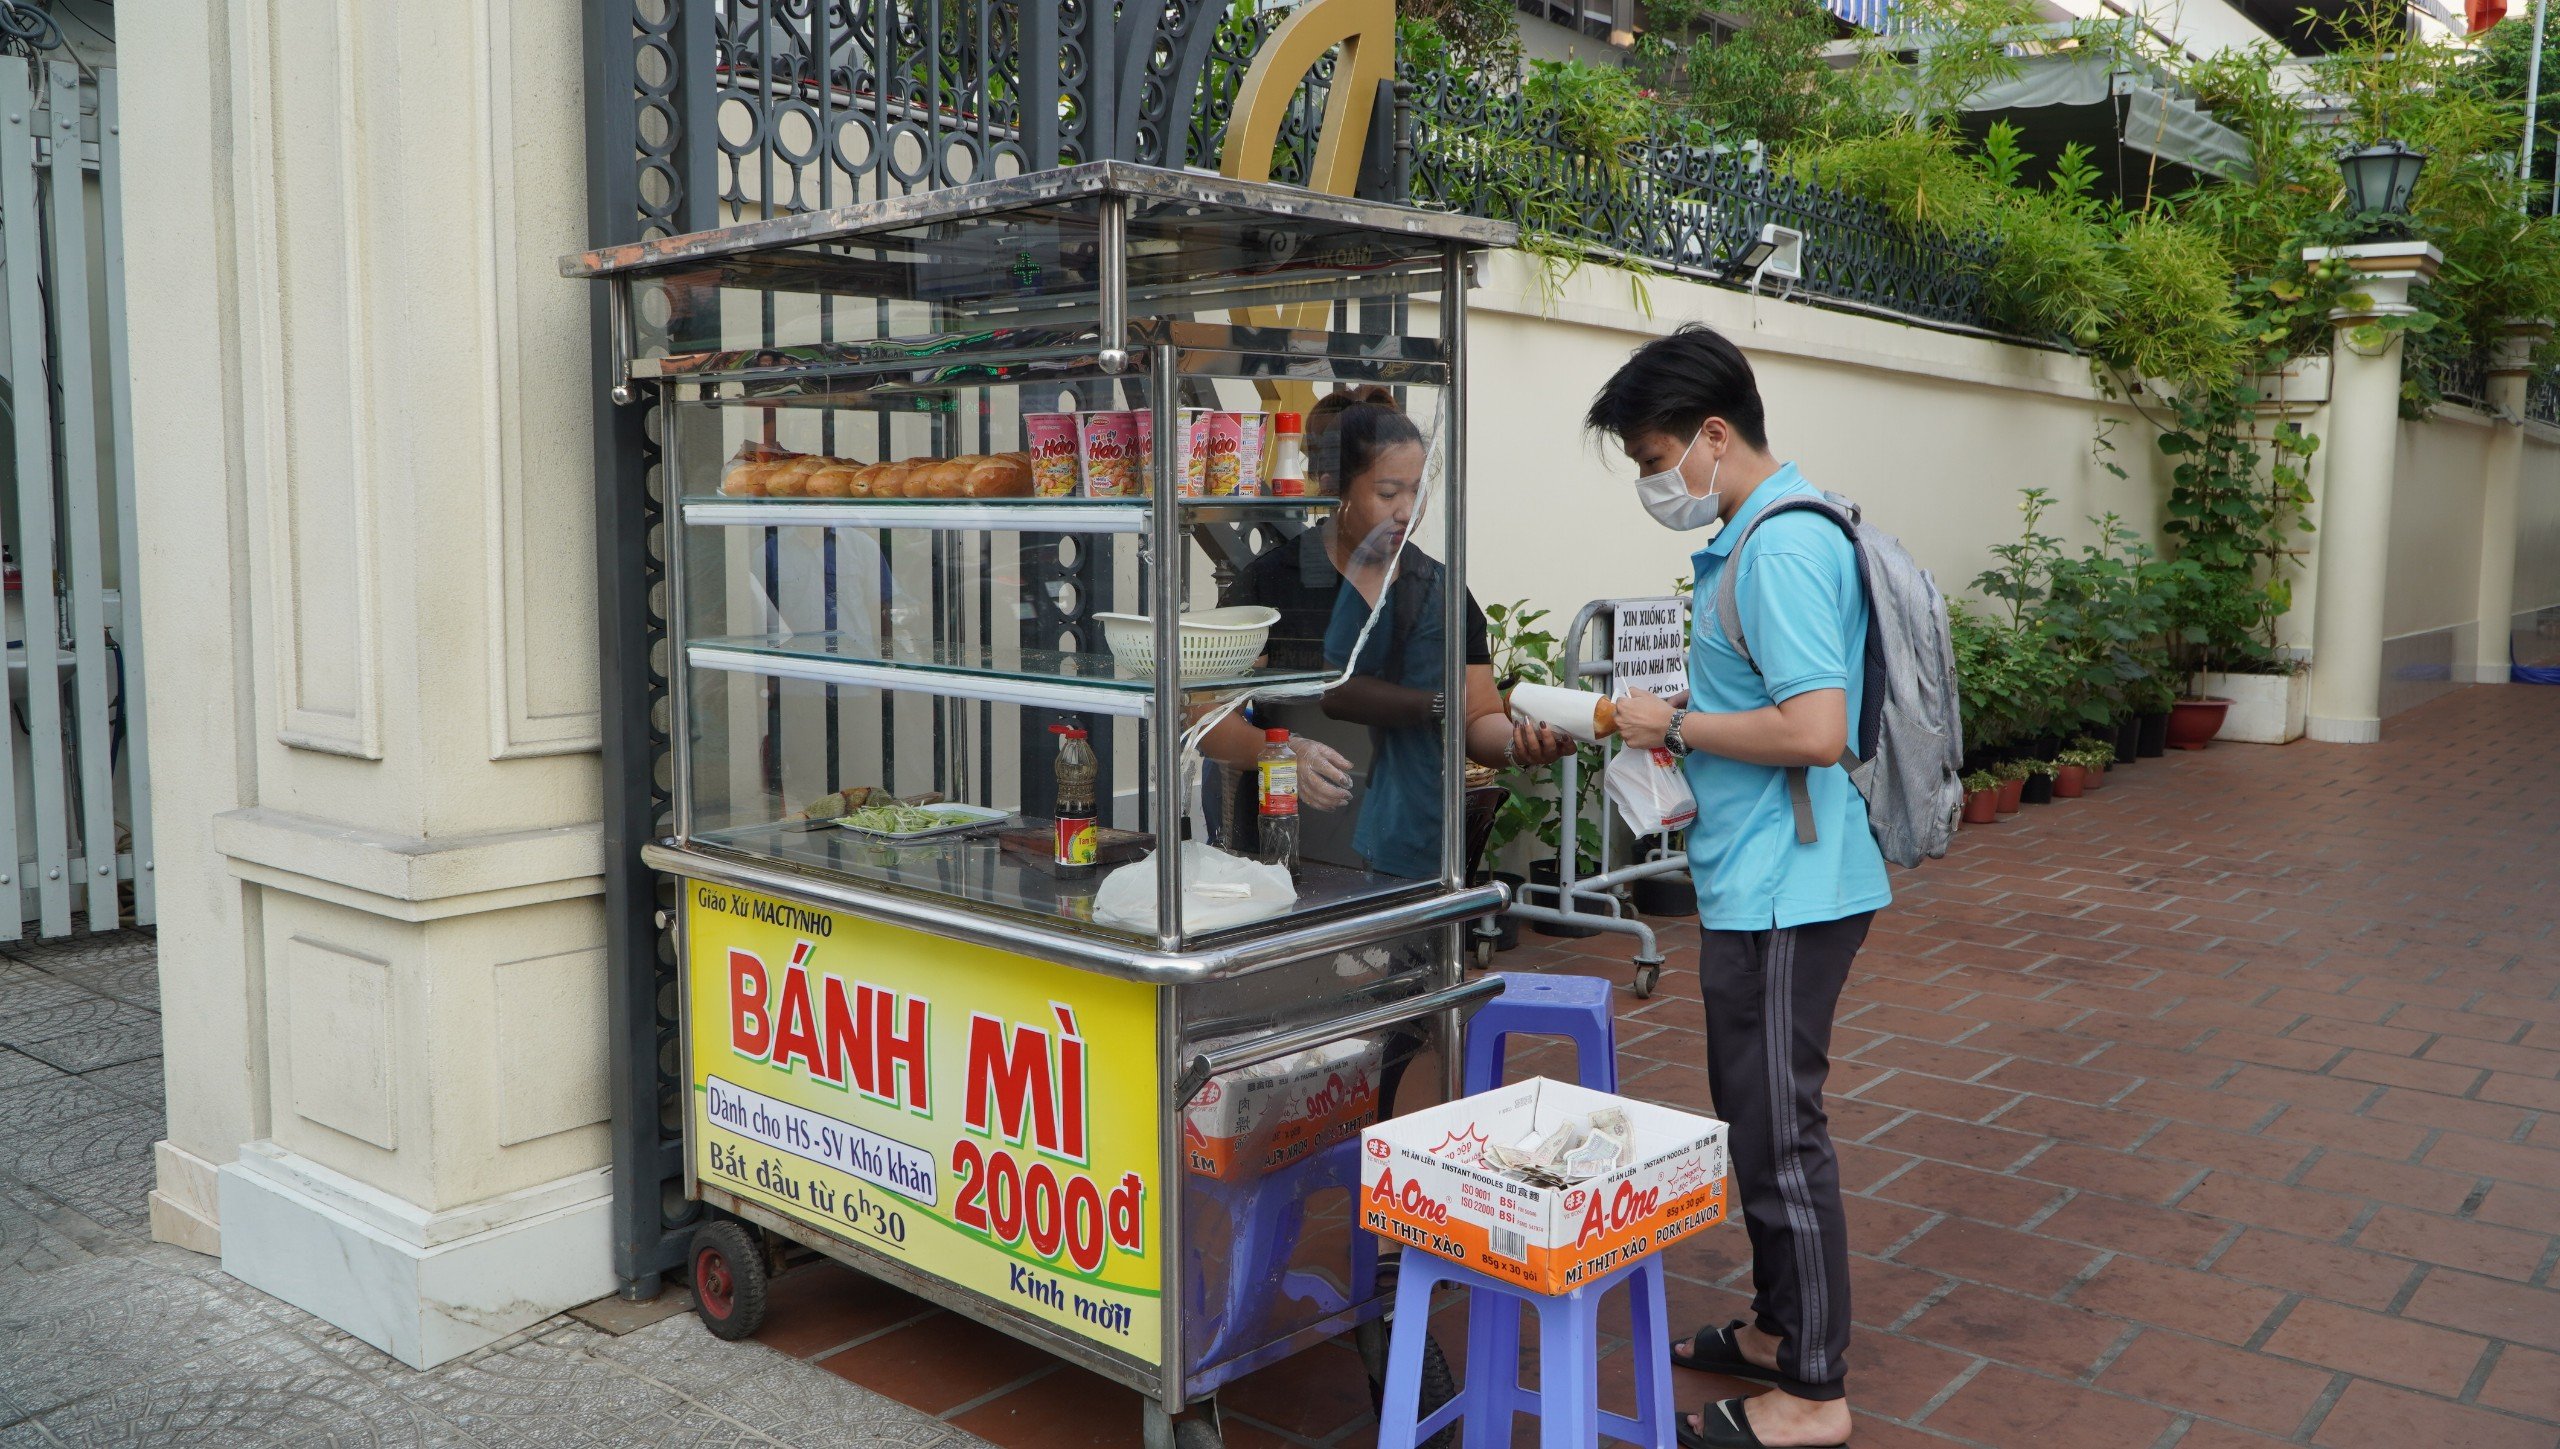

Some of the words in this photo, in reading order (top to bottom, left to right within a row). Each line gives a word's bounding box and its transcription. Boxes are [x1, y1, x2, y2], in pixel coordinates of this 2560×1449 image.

[1089, 438, 1123, 461] Hảo
[1623, 611, 1637, 627] XIN
[1640, 605, 1666, 626] XUỐNG
[1667, 609, 1676, 625] XE
[1618, 631, 1633, 652] TẮT
[1631, 657, 1647, 676] VÀO
[1649, 655, 1664, 675] NHÀ
[698, 887, 726, 913] Giáo
[730, 894, 750, 918] Xứ
[752, 899, 833, 938] MACTYNHO
[728, 940, 932, 1116] BÁNH
[965, 1001, 1088, 1166] MÌ
[710, 1086, 748, 1128] Dành
[752, 1103, 781, 1140] cho
[850, 1136, 883, 1177] Khó
[888, 1147, 932, 1196] khăn
[1643, 1156, 1666, 1170] INSTANT
[1666, 1145, 1690, 1160] NOODLES
[710, 1141, 748, 1181] Bắt
[756, 1158, 800, 1201] đầu
[809, 1180, 836, 1214] từ
[1441, 1162, 1471, 1178] INSTANT
[1472, 1172, 1504, 1189] NOODLES
[952, 1140, 1144, 1274] 2000đ
[1372, 1167, 1447, 1225] A-One
[1461, 1183, 1474, 1195] ISO
[1474, 1187, 1491, 1201] 9001
[1500, 1196, 1516, 1210] BSi
[1461, 1197, 1473, 1209] ISO
[1474, 1200, 1495, 1217] 22000
[1499, 1210, 1515, 1224] BSi
[1576, 1180, 1659, 1250] A-One
[1666, 1206, 1679, 1217] 85g
[1685, 1200, 1694, 1209] 30
[1695, 1194, 1706, 1207] gói
[1368, 1211, 1387, 1231] MÌ
[1391, 1219, 1428, 1247] THỊT
[1432, 1232, 1465, 1259] XÀO
[1566, 1261, 1584, 1286] MÌ
[1587, 1249, 1618, 1274] THỊT
[1621, 1238, 1647, 1260] XÀO
[1656, 1222, 1683, 1245] PORK
[1684, 1203, 1720, 1229] FLAVOR
[1482, 1254, 1499, 1270] 85g
[1501, 1262, 1507, 1271] x
[1509, 1264, 1521, 1276] 30
[1523, 1270, 1538, 1282] gói
[1009, 1262, 1064, 1310] Kính
[1074, 1292, 1132, 1337] mời!
